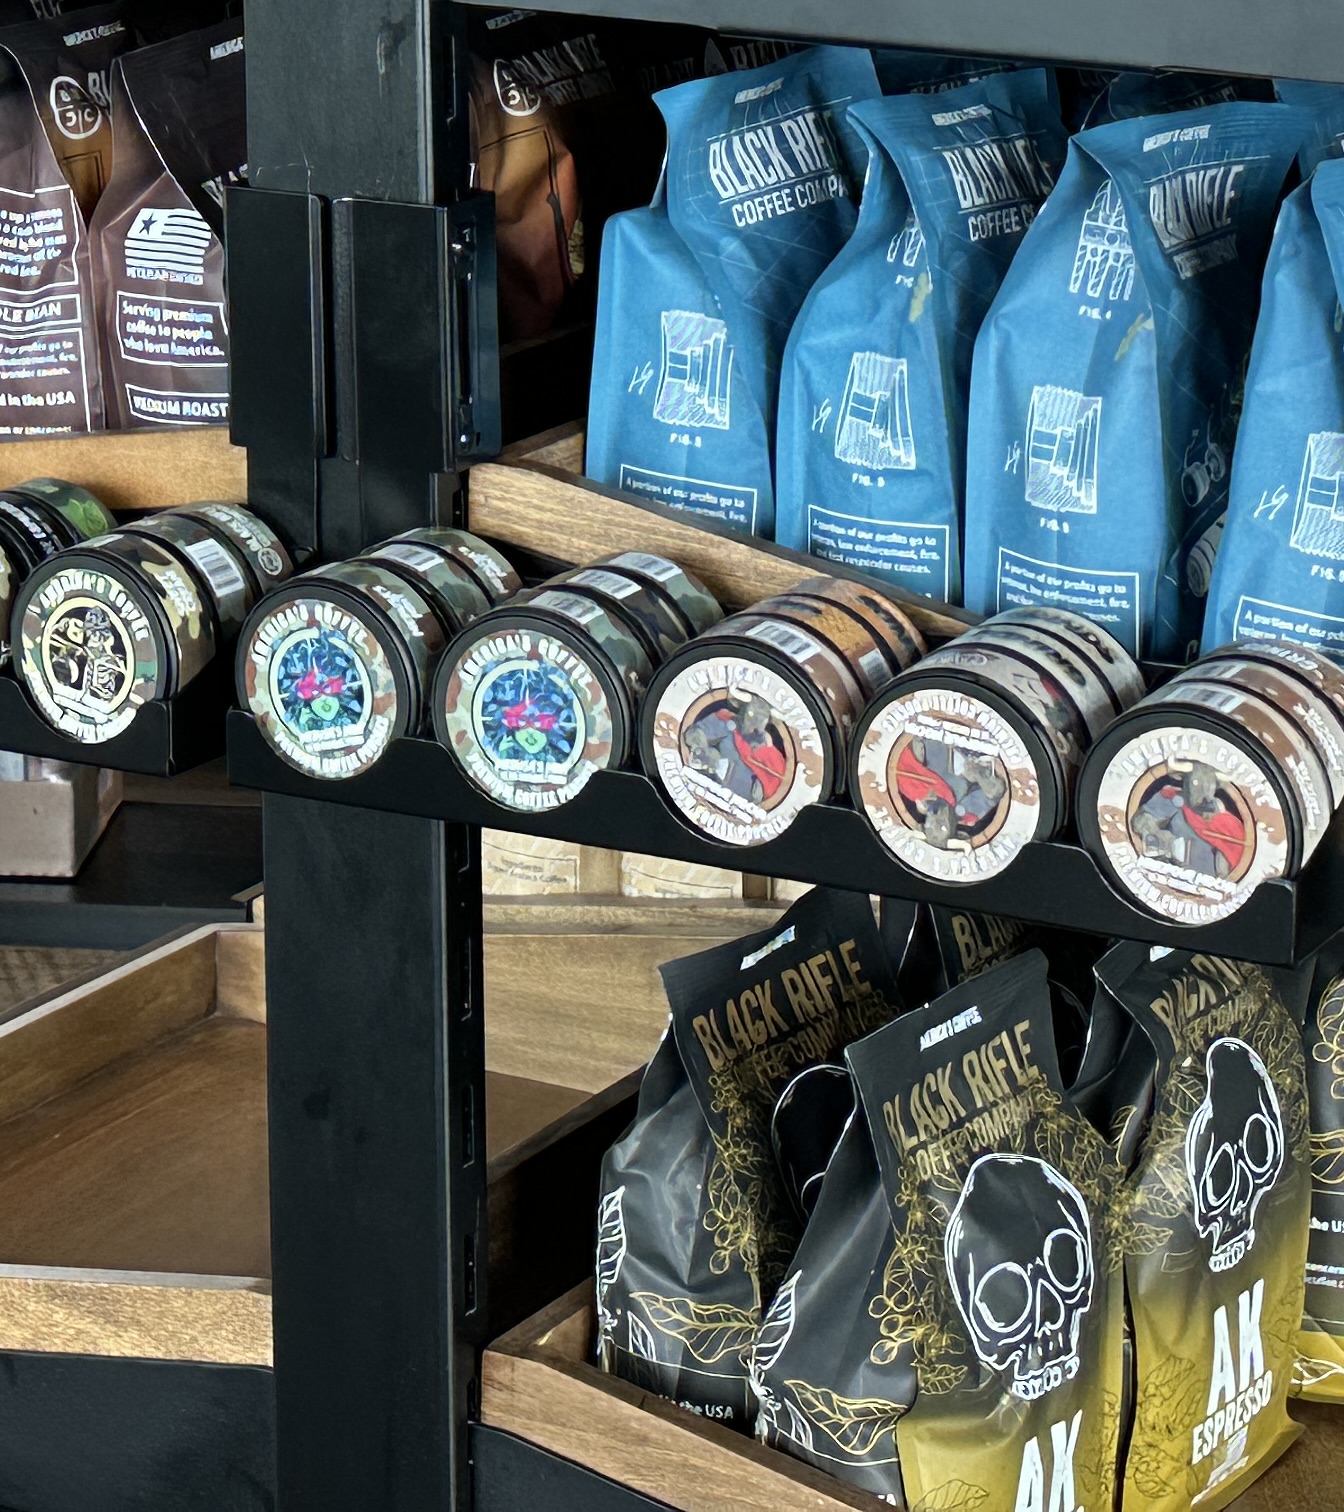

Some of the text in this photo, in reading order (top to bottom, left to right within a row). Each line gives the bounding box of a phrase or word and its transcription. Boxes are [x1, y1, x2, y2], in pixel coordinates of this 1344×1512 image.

[708, 125, 795, 199] BLACK
[731, 187, 795, 227] COFFEE
[46, 391, 75, 405] USA
[182, 401, 228, 417] ROAST
[692, 939, 872, 1073] BLACK RIFLE
[882, 1019, 1040, 1156] BLACK RIFLE
[1206, 1278, 1266, 1418] AK
[704, 1401, 735, 1420] USA
[1191, 1370, 1273, 1466] ESPRESSO
[1015, 1409, 1087, 1512] AK
